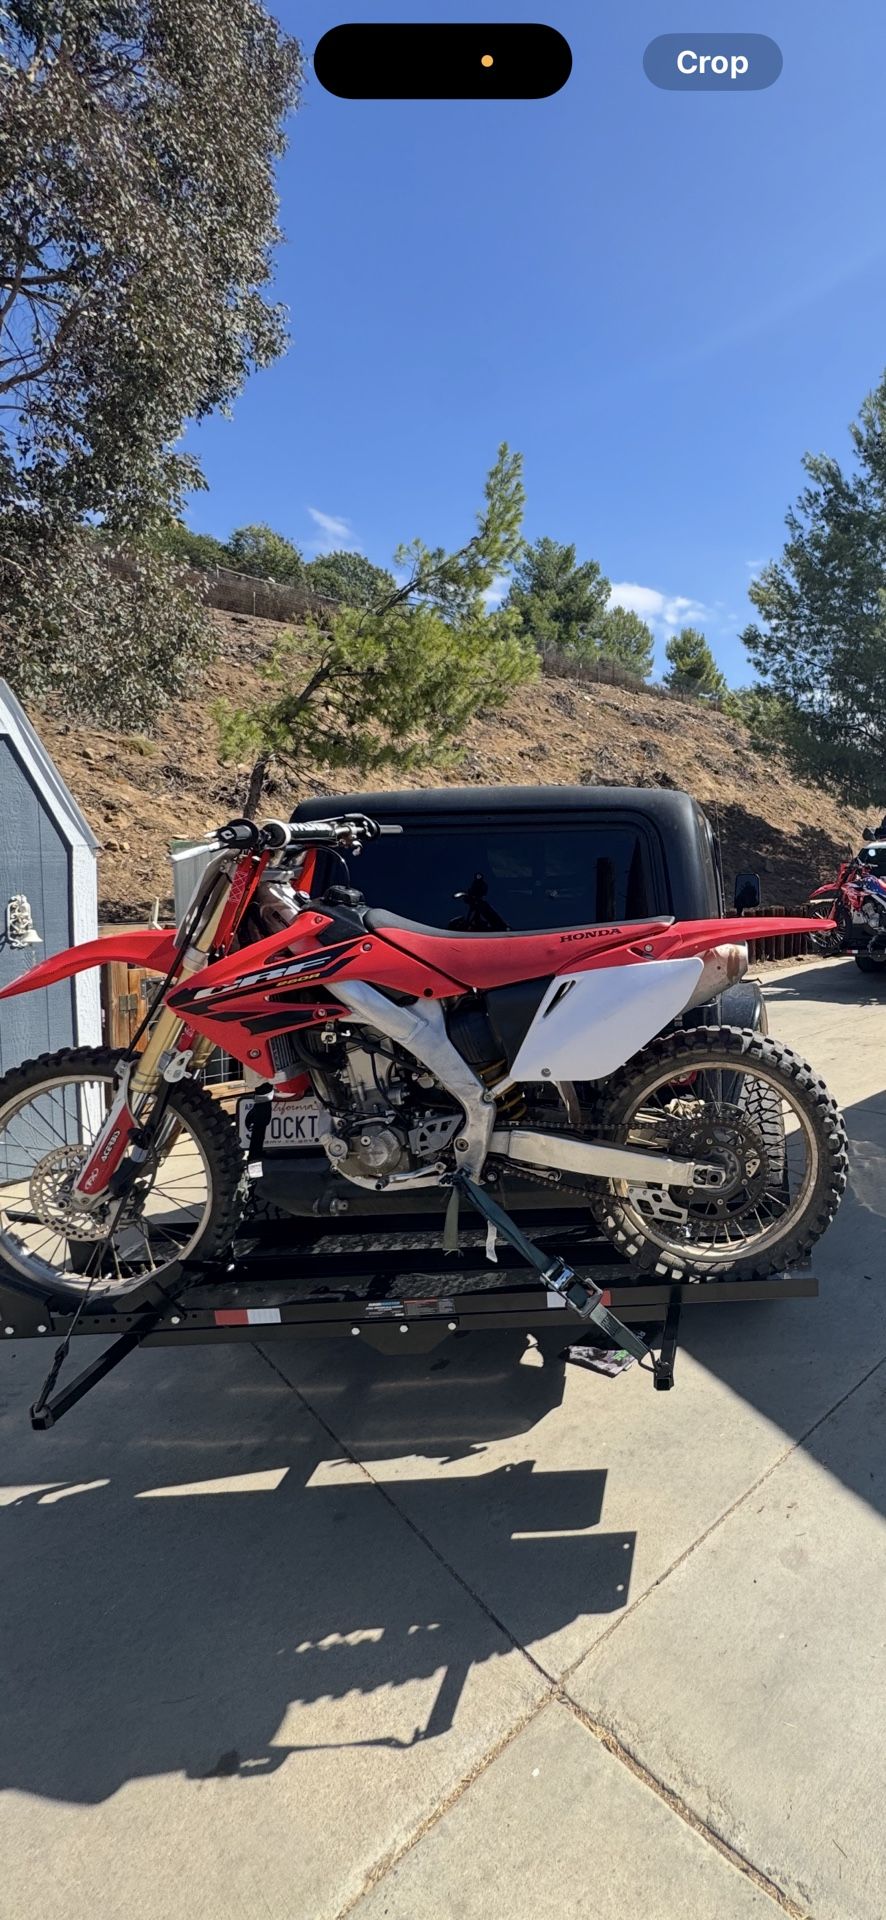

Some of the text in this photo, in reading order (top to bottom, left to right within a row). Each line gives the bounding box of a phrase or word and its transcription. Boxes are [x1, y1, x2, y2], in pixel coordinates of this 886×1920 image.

[560, 928, 622, 943] HONDA
[193, 956, 332, 1000] CRF
[272, 1101, 319, 1115] lifornia
